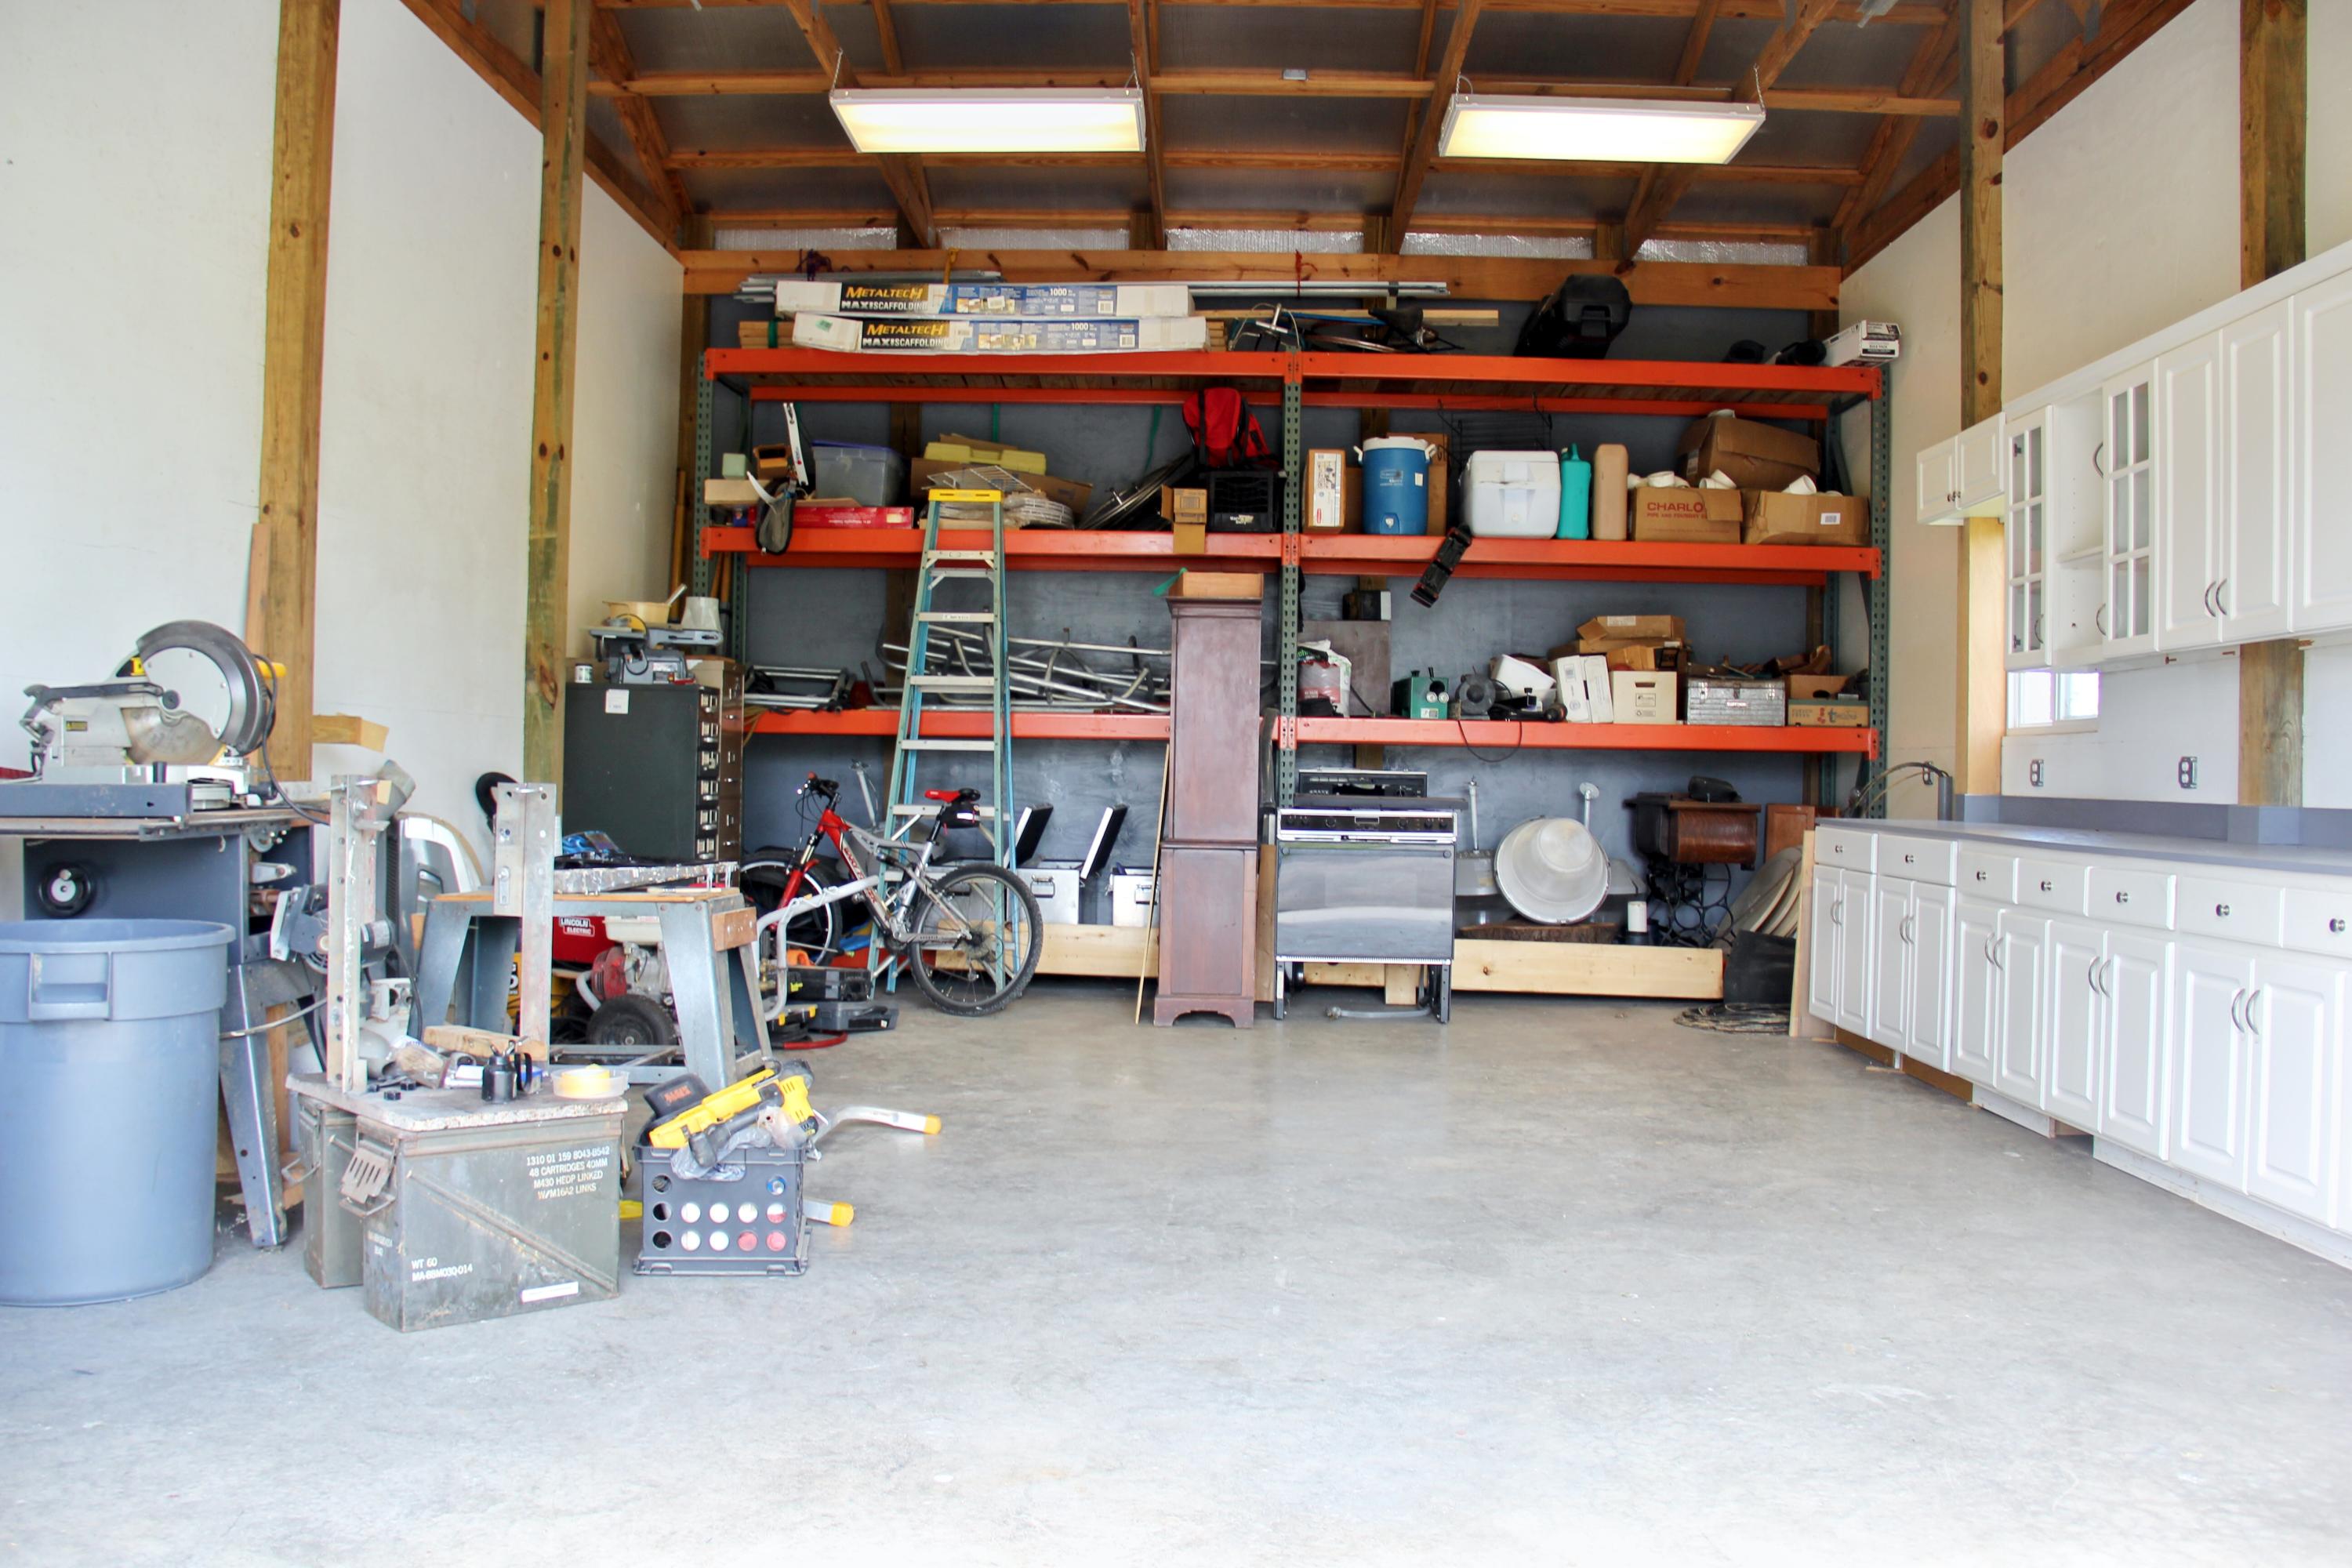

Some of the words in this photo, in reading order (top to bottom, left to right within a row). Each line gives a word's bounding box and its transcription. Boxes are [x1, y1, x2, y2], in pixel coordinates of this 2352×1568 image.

[846, 287, 923, 299] METALTECH
[1050, 288, 1067, 296] 1000
[867, 325, 943, 336] METALTECH
[1646, 502, 1704, 513] CHARLO
[560, 917, 590, 927] LINCOLN
[566, 926, 592, 935] ELECTRIC
[526, 1156, 545, 1166] 1310
[546, 1153, 556, 1163] 01
[558, 1151, 572, 1162] 159
[528, 1167, 539, 1178] 48
[540, 1161, 585, 1176] CARTRIDGES
[586, 1158, 608, 1168] 40MM
[534, 1178, 554, 1189] M430
[556, 1174, 576, 1185] HEDP
[577, 1170, 603, 1182] LINKED
[575, 1182, 597, 1194] LINKS
[411, 1258, 424, 1269] WT
[426, 1257, 437, 1267] 60
